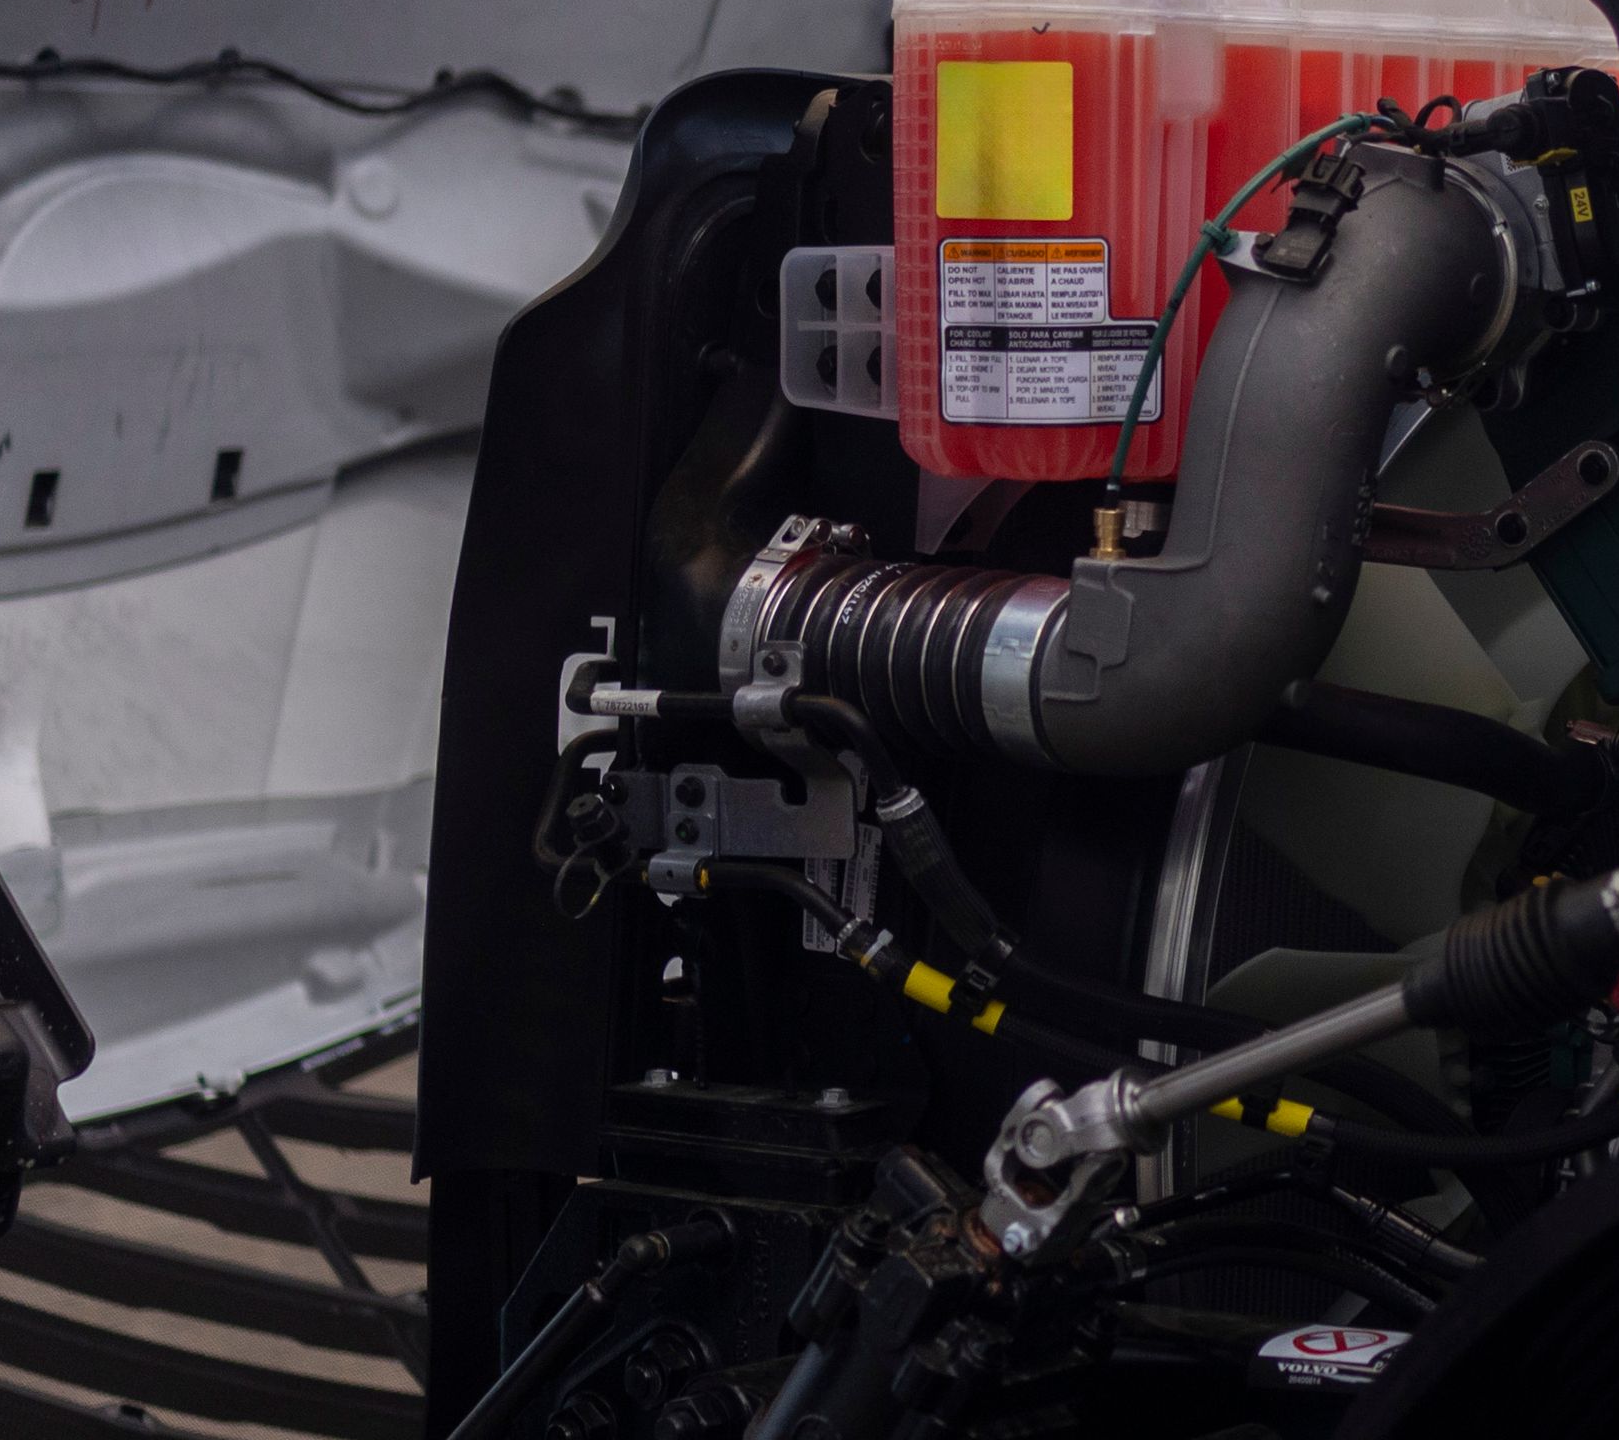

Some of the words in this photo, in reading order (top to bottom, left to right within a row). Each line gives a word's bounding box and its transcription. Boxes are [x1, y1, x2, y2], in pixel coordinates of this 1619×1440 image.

[1574, 191, 1590, 218] 24V
[1005, 248, 1046, 258] CUIDADO
[962, 266, 978, 274] NOT
[997, 267, 1035, 275] CALIENTE
[948, 277, 971, 285] OPEN
[972, 277, 987, 285] HOT
[997, 277, 1007, 285] NO
[1008, 277, 1034, 285] ABRIR
[1058, 277, 1084, 285] CHAUD
[948, 290, 965, 298] FILL
[968, 290, 977, 298] TO
[1006, 312, 1034, 320] TANQUE
[1051, 312, 1060, 320] LE
[949, 330, 965, 338] FOR
[967, 330, 992, 338] COOLANT
[1009, 331, 1028, 339] SOLO
[1031, 331, 1051, 339] PARA
[1053, 331, 1084, 339] CAMBIAR
[1016, 356, 1041, 364] LLENAR
[1044, 356, 1049, 364] A
[1052, 356, 1068, 364] TOPE
[1016, 366, 1037, 374] DEJAR
[1039, 366, 1064, 374] MOTOR
[1016, 376, 1050, 384] FUNCIONAR
[1054, 376, 1065, 384] SIN
[1067, 376, 1088, 384] CARGA
[955, 395, 970, 403] FULL
[1277, 1361, 1339, 1375] VOLVO
